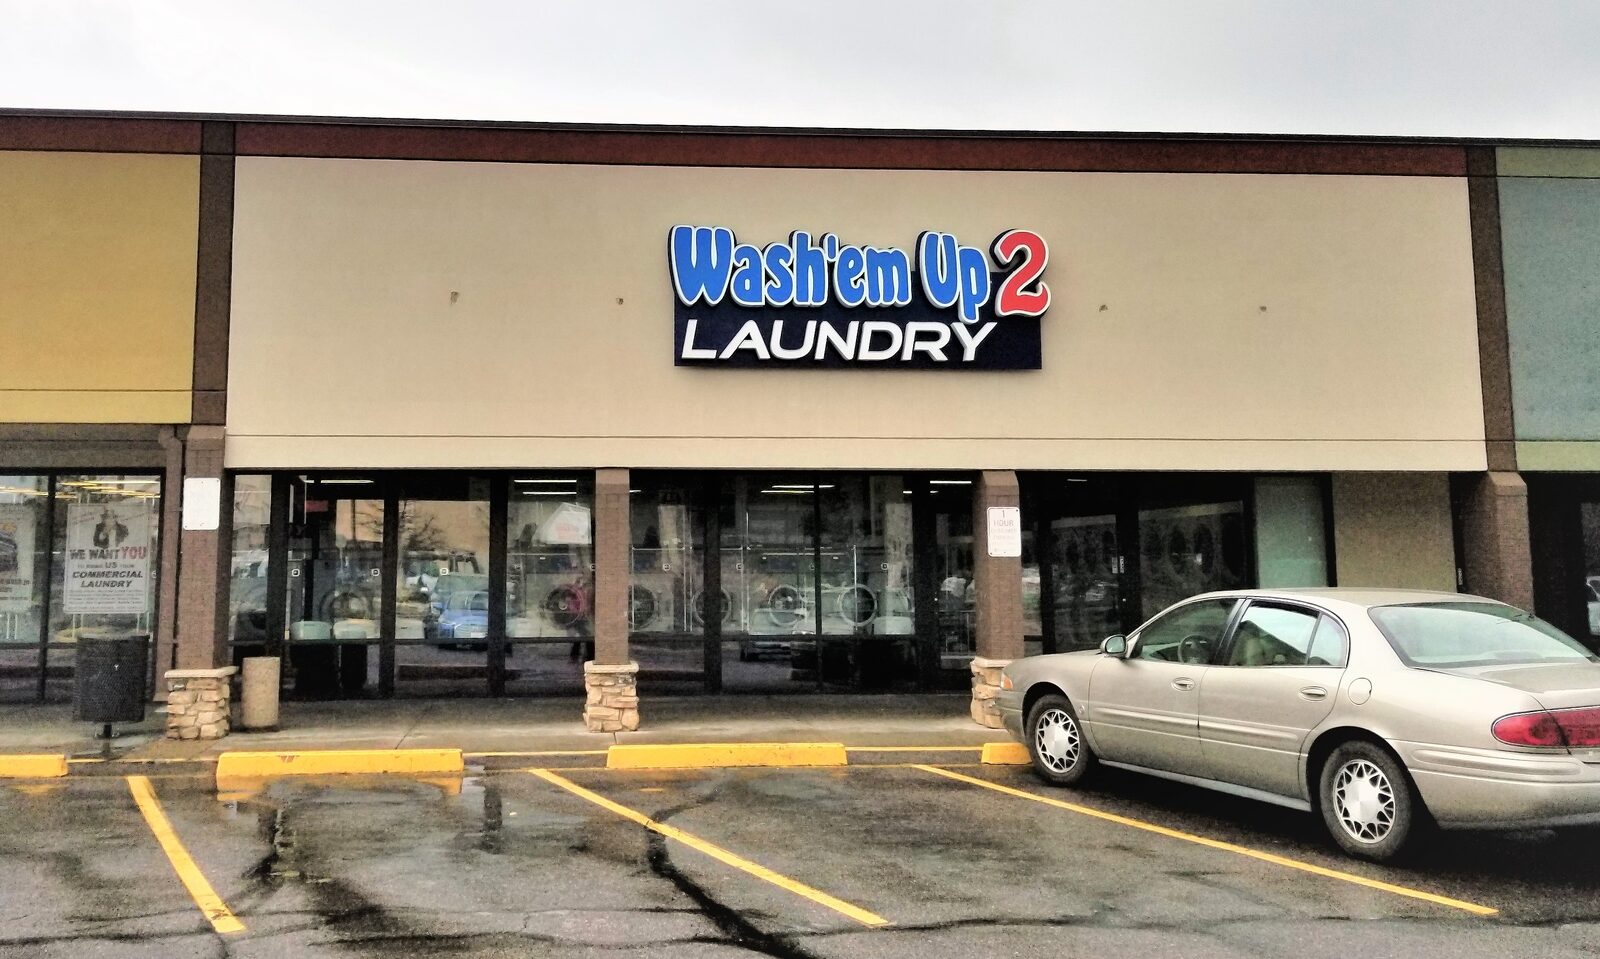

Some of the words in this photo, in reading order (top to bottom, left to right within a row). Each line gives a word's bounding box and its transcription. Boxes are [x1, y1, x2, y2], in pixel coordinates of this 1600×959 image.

[669, 225, 912, 307] Wash'em
[917, 230, 991, 324] Up
[991, 228, 1052, 317] 2
[681, 319, 998, 362] LAUNDRY
[69, 549, 85, 560] WE
[89, 549, 120, 560] WANT
[120, 546, 147, 560] YOU
[72, 570, 143, 579] COMMERCIAL
[80, 580, 133, 588] LAUNDRY
